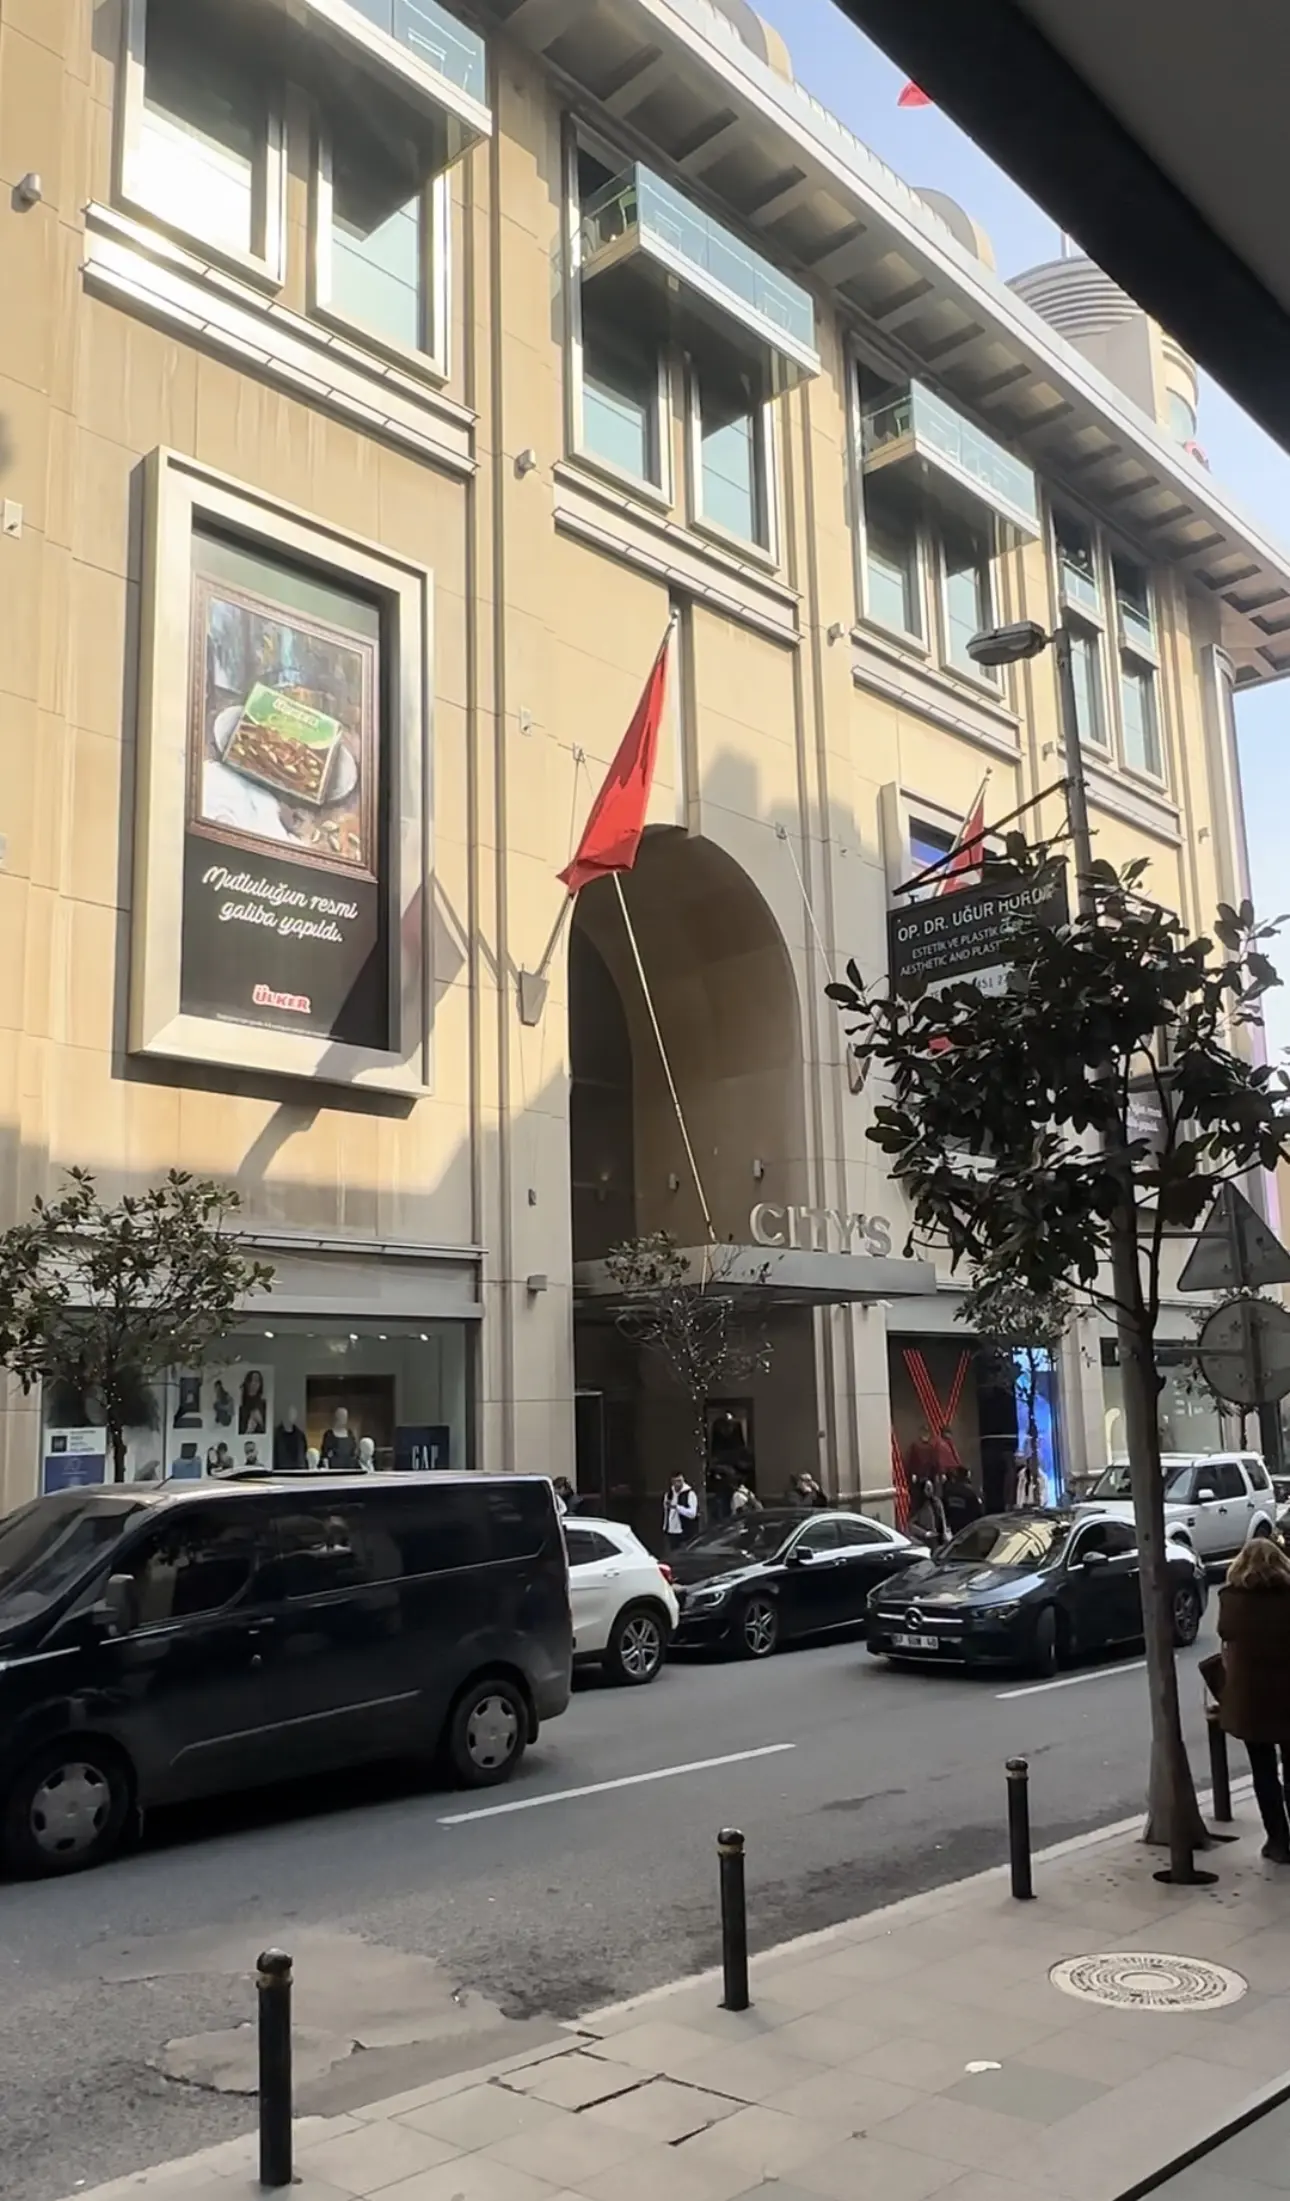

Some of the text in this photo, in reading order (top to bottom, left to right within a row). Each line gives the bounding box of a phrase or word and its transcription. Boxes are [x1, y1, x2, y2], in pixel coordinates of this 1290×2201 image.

[202, 865, 358, 919] Mutluluğun resmi
[218, 901, 343, 942] galiba yapıldı.
[897, 924, 920, 942] OP.
[923, 915, 949, 934] DR.
[952, 901, 994, 926] UĞUR
[947, 936, 959, 949] VE
[900, 954, 948, 977] AESTHETIC
[949, 948, 971, 963] AND
[252, 984, 311, 1014] ÜLKER
[750, 1203, 892, 1258] CITY'S
[412, 1445, 439, 1470] GAP
